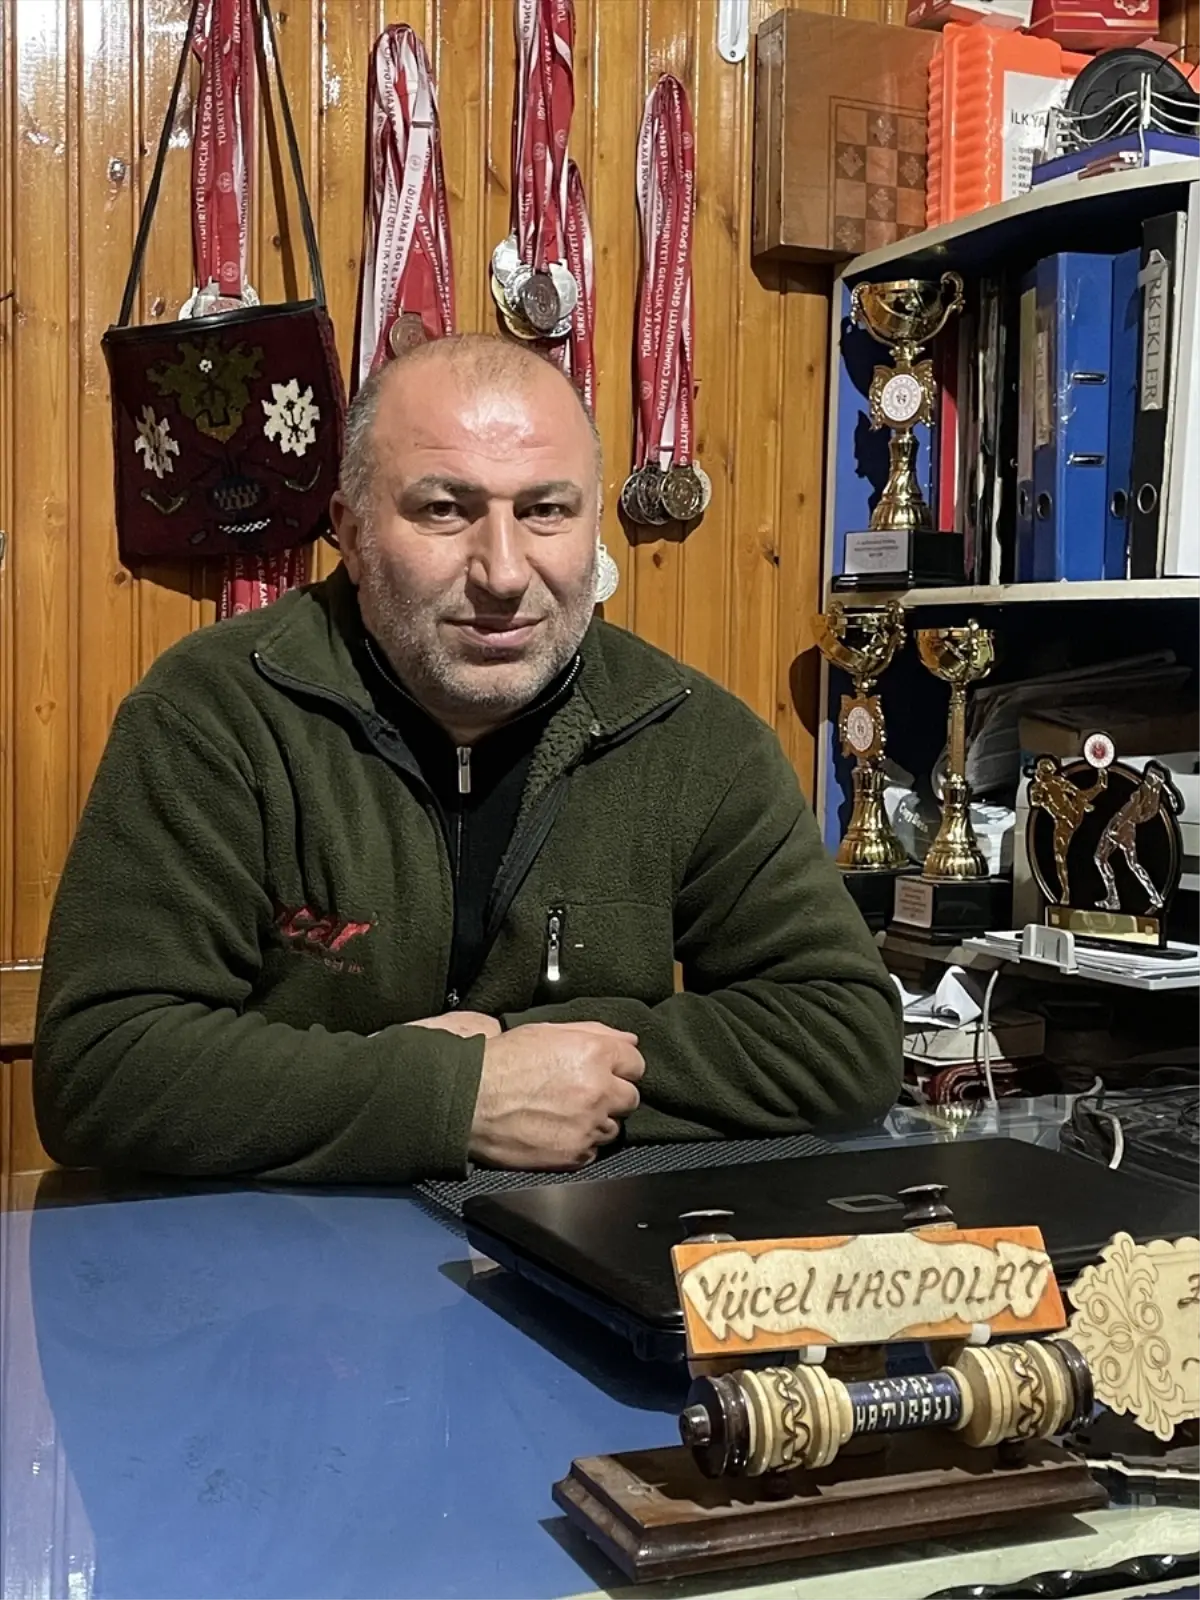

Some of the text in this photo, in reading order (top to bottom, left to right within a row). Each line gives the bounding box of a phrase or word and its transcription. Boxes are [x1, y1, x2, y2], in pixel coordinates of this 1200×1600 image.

[201, 124, 211, 137] VE
[203, 95, 214, 123] SPOR
[215, 100, 227, 146] TÜRKİYE
[197, 140, 210, 184] GENÇLİK
[657, 169, 693, 420] TÜRKİYE CUMHURİYETİ GENÇLİK VE SPOR BAKANLIĞI
[576, 301, 586, 343] TÜRKİYE
[642, 317, 652, 358] TÜRKİYE
[1145, 260, 1163, 399] RKEKLER
[699, 1259, 1050, 1322] Yücel HASPOLAT
[855, 1395, 952, 1432] HATIRASI
